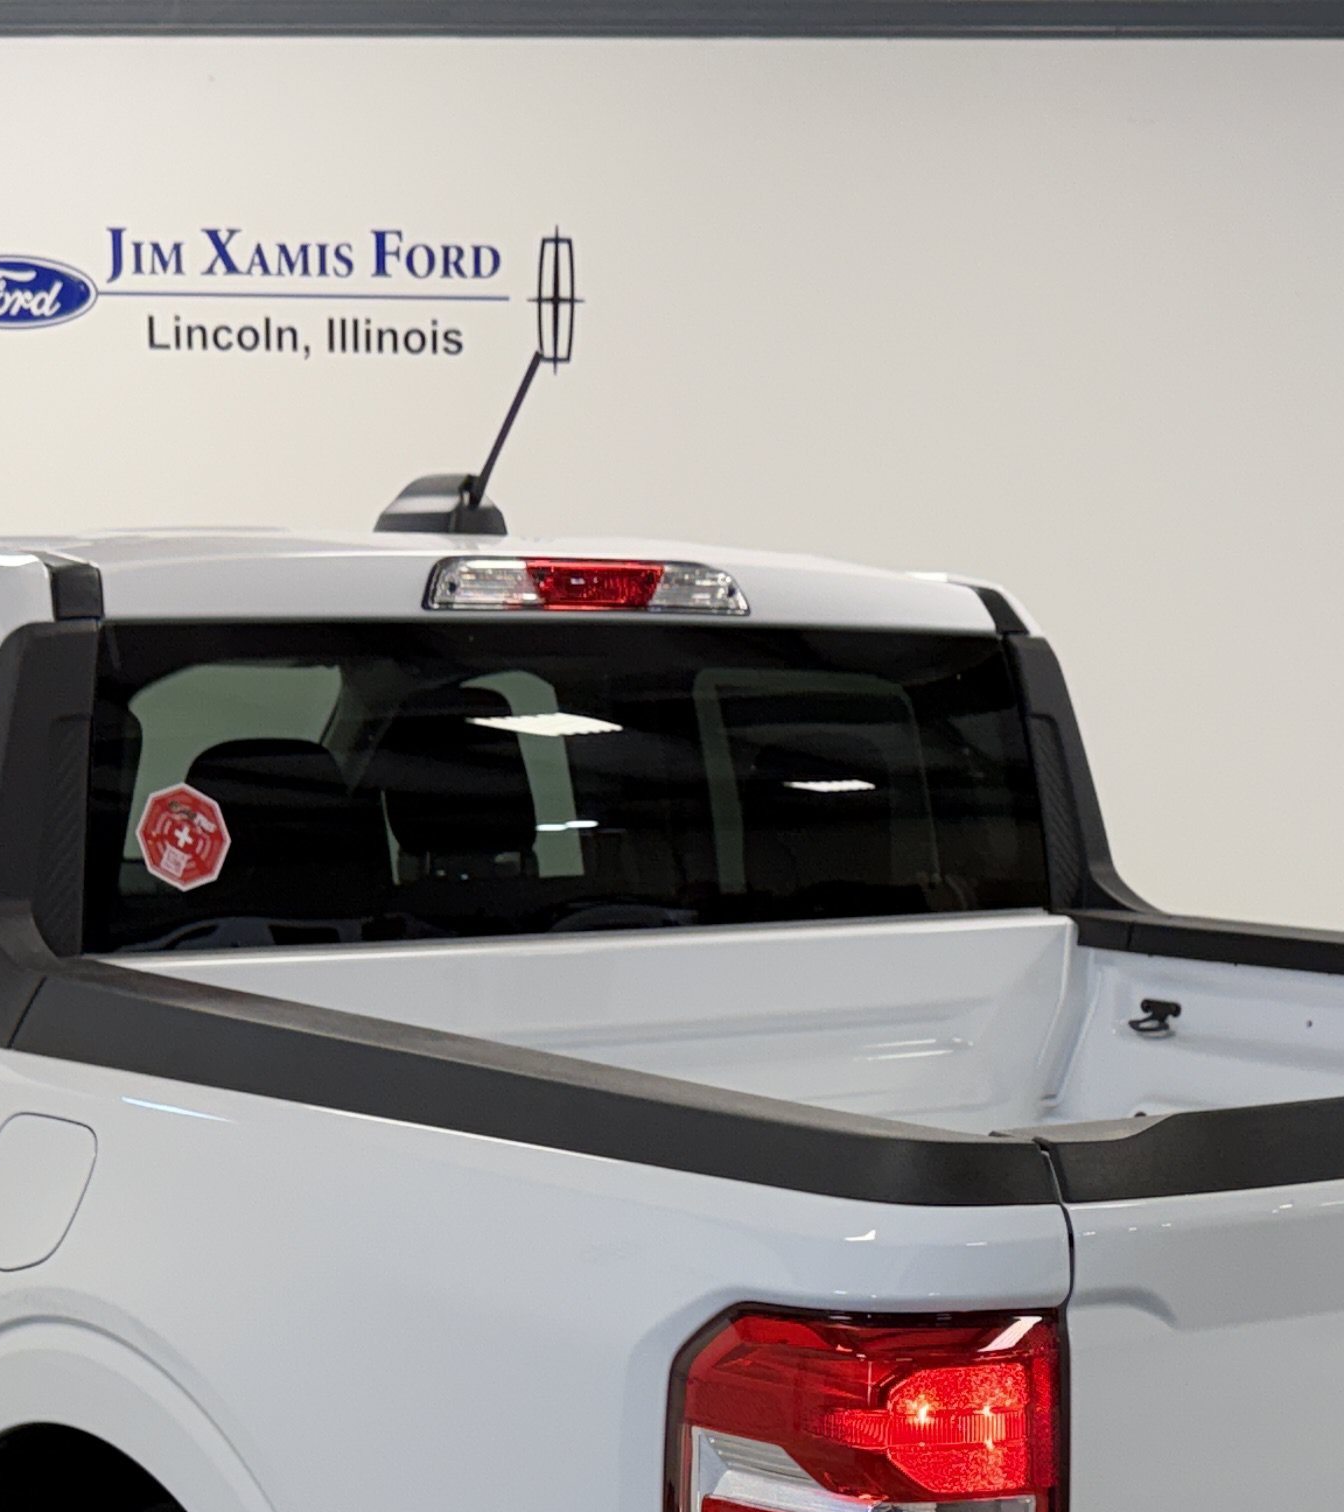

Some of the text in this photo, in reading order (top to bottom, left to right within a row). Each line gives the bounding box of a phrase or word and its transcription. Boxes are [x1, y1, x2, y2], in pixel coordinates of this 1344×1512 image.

[106, 227, 502, 283] JIM XAMIS FORD
[147, 316, 464, 360] Lincoln, Illinois
